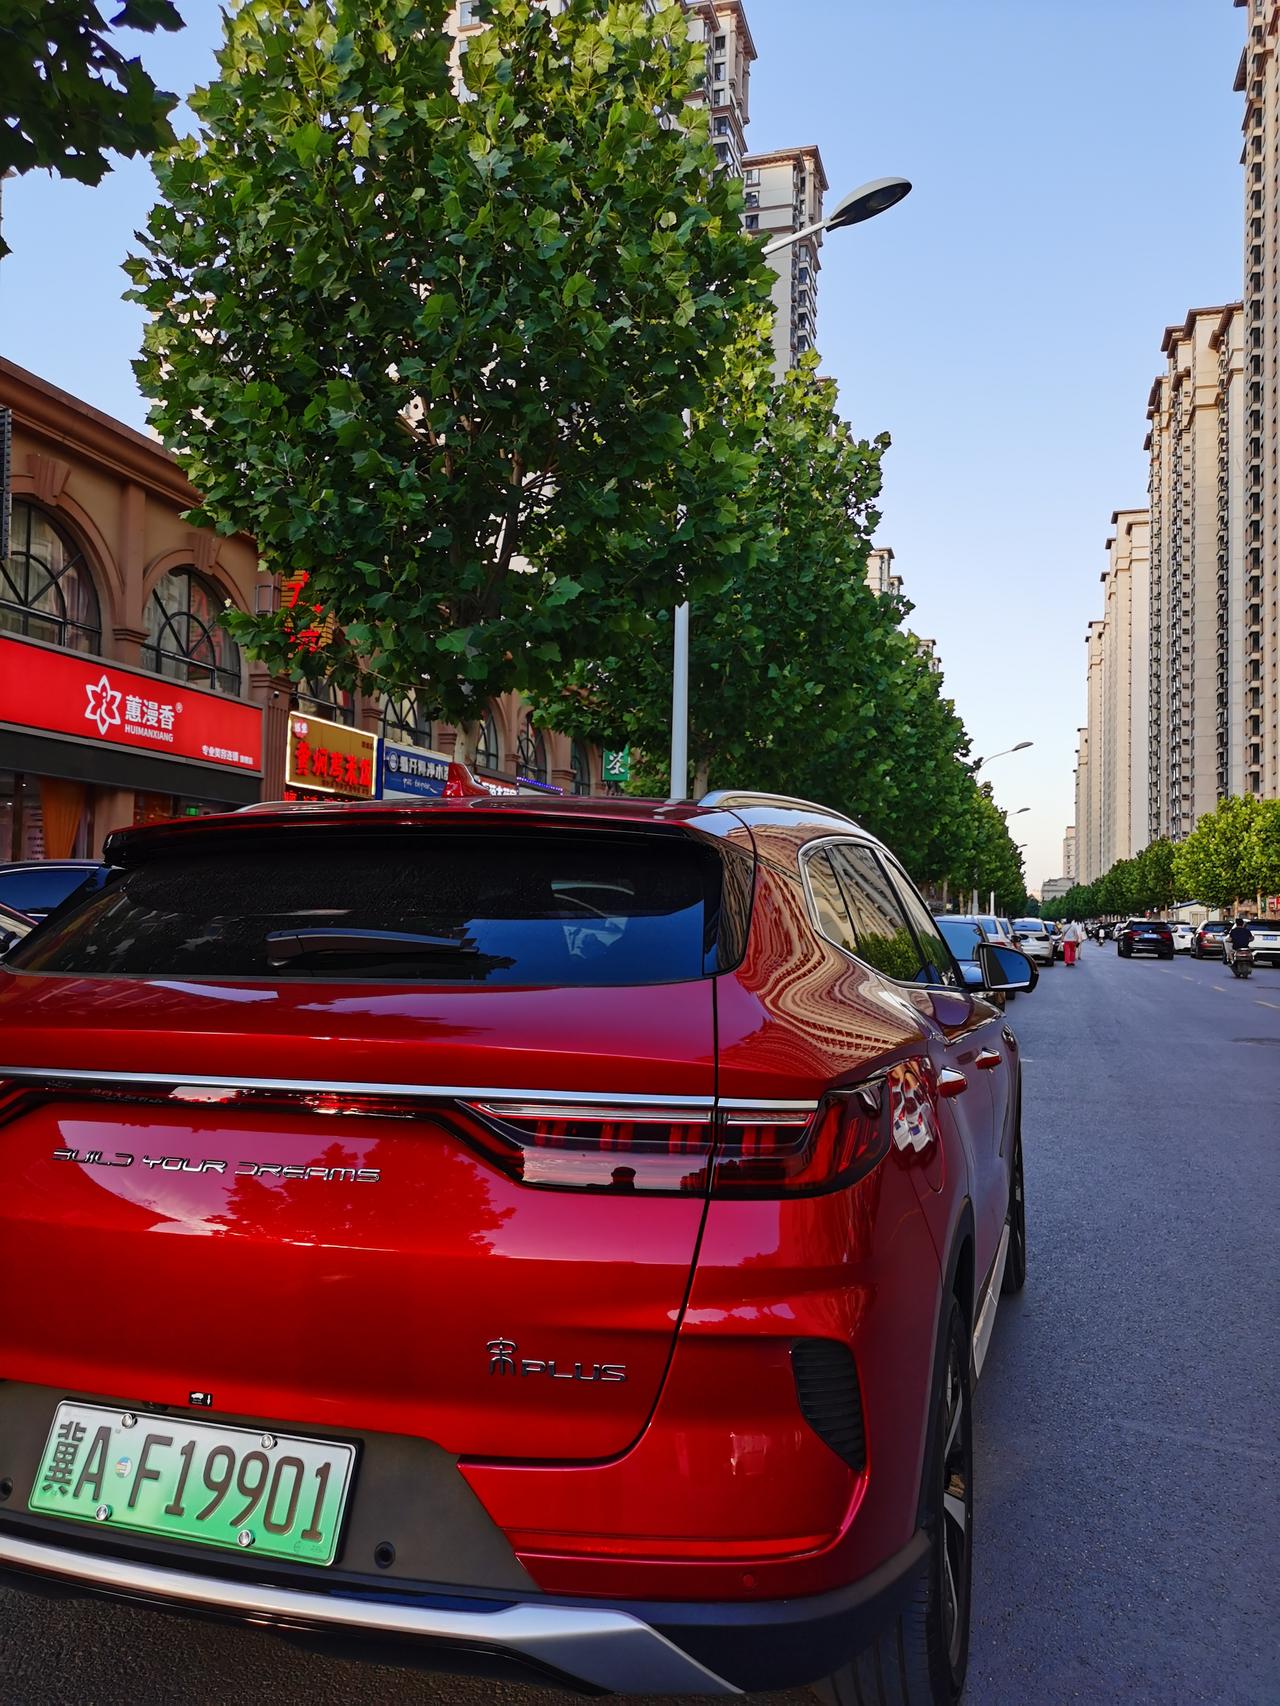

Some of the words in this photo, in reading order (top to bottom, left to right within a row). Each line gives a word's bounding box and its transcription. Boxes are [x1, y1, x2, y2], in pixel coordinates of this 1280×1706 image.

[124, 723, 174, 743] HUIMANXIANG
[606, 751, 626, 774] 茶
[50, 1147, 134, 1167] BUILD
[142, 1154, 227, 1174] YOUR
[235, 1162, 382, 1184] DREAMS
[521, 1360, 628, 1382] PLUS
